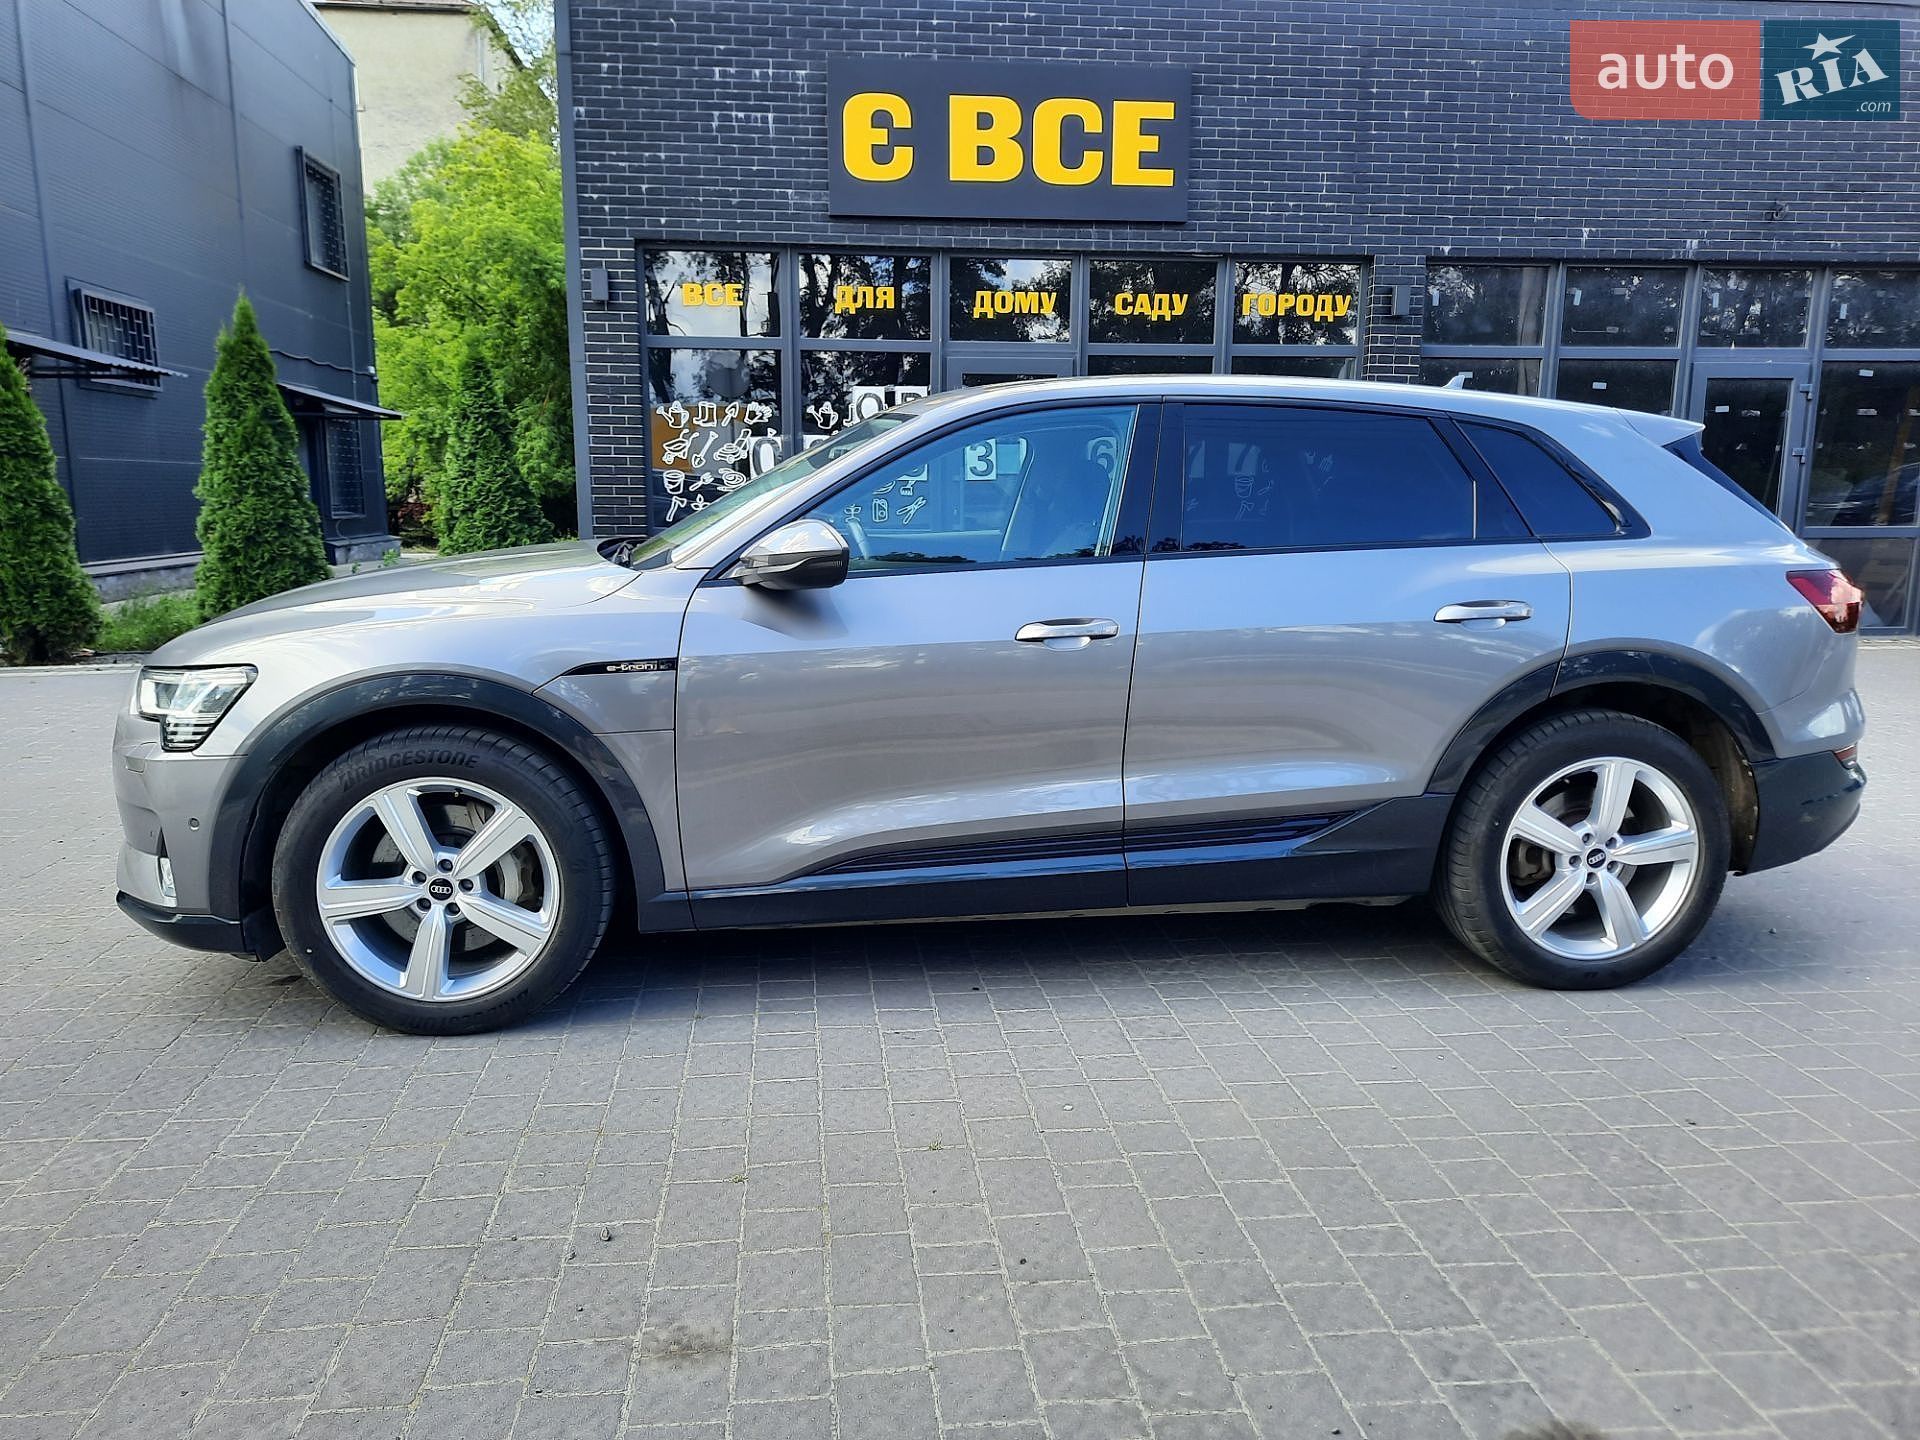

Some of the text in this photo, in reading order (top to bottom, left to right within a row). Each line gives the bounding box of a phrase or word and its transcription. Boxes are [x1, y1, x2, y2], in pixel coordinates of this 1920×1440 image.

[843, 92, 1175, 187] Є ВСЕ
[681, 282, 1352, 322] ВСЕ ДЛЯ ДОМУ САДУ ГОРОДУ
[337, 749, 480, 792] BRIDGESTONE
